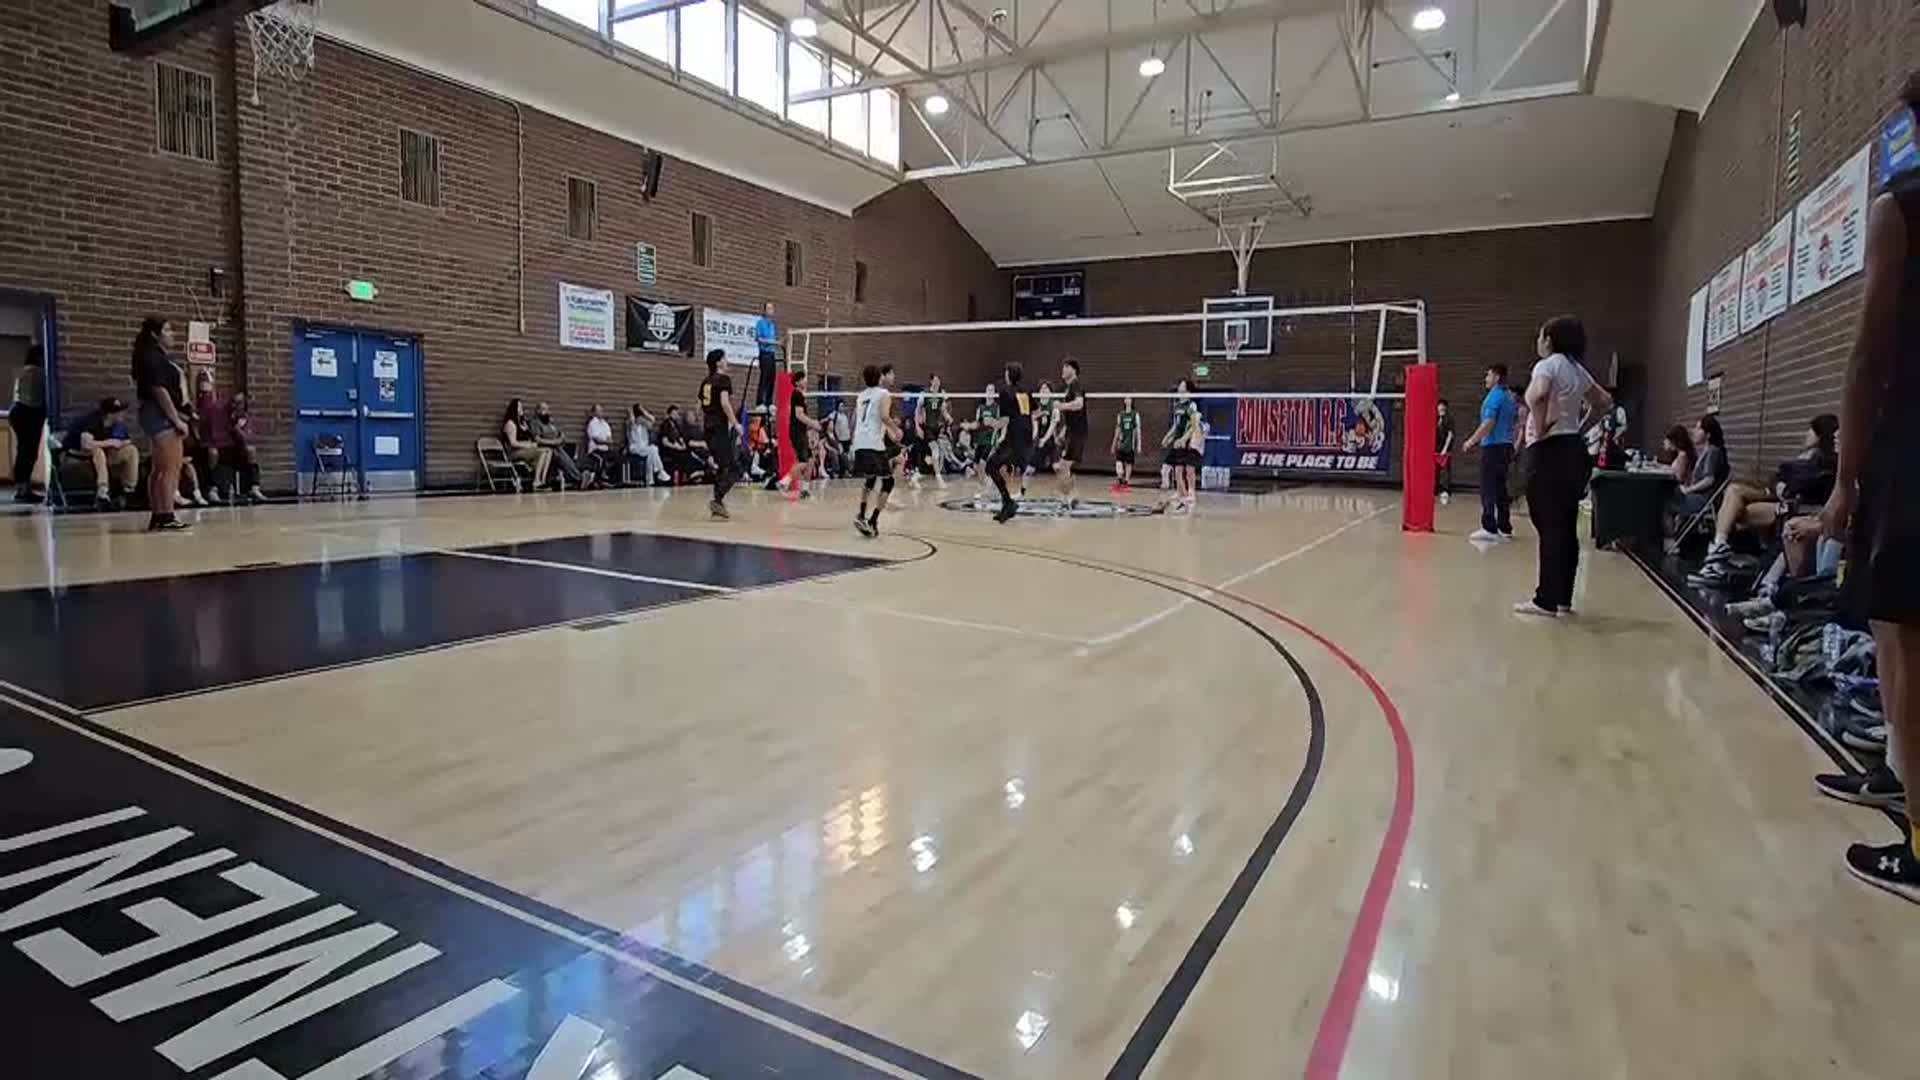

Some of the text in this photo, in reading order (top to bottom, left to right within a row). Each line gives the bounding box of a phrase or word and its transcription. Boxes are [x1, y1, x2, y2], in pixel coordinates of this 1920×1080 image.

[1236, 398, 1316, 446] POINSETTIA
[1241, 452, 1379, 470] IS THE PLACE TO BE
